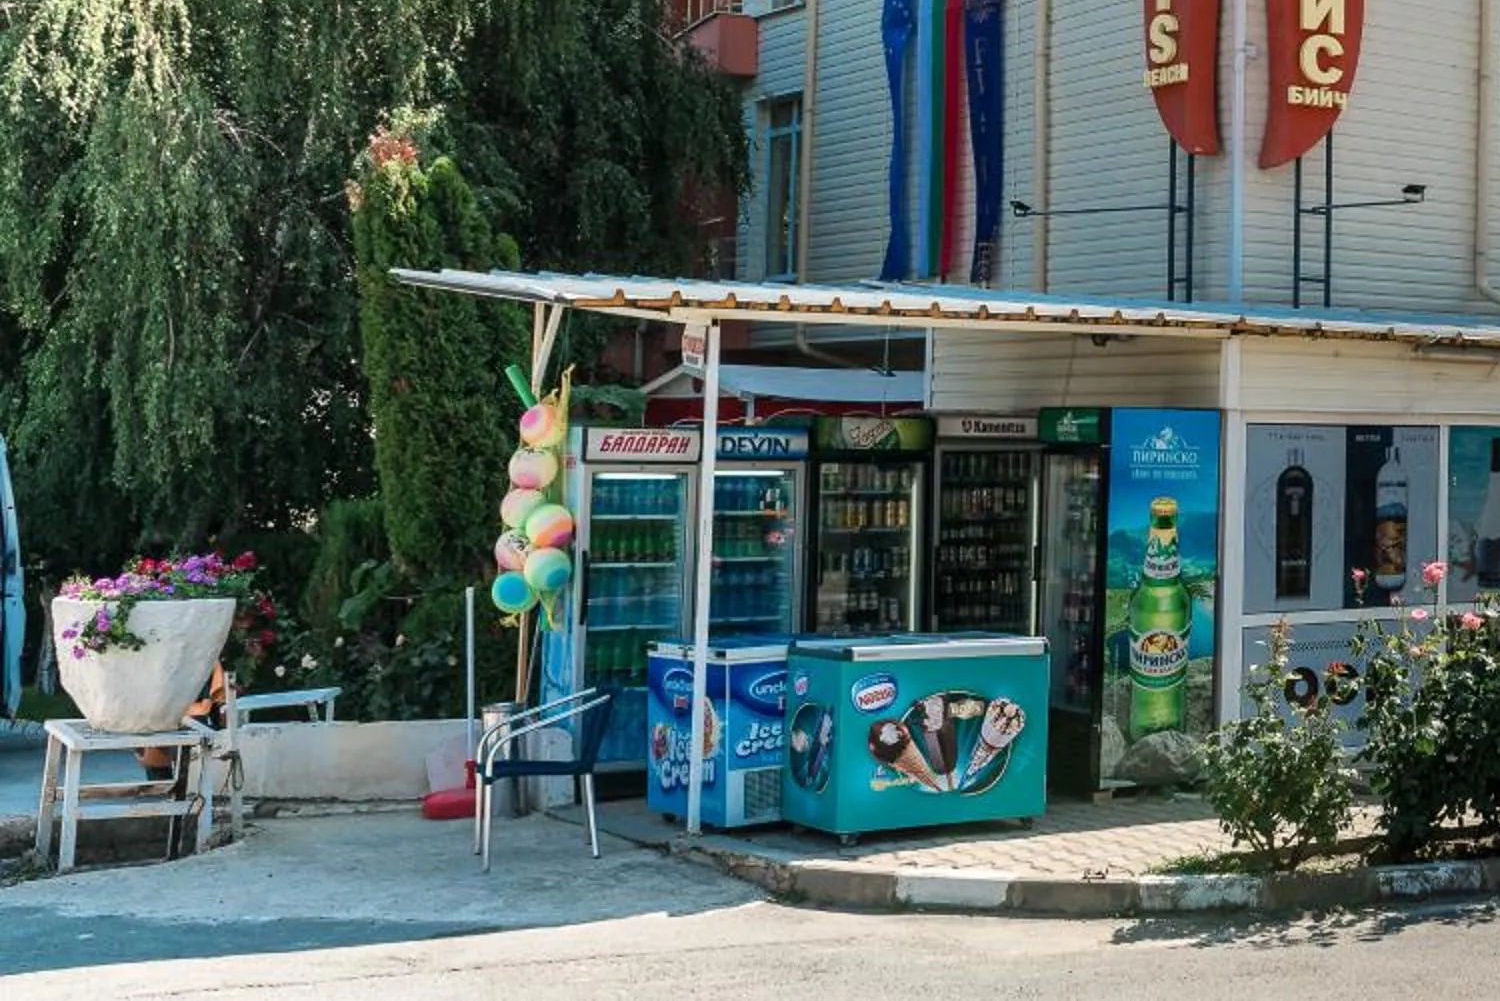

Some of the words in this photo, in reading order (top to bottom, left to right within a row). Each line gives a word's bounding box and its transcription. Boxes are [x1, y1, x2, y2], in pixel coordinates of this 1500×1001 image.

[1143, 62, 1189, 88] BEACH
[1287, 85, 1349, 111] БИЙЧ
[600, 434, 692, 454] БАЛДАРАН
[721, 433, 791, 456] DEVIN
